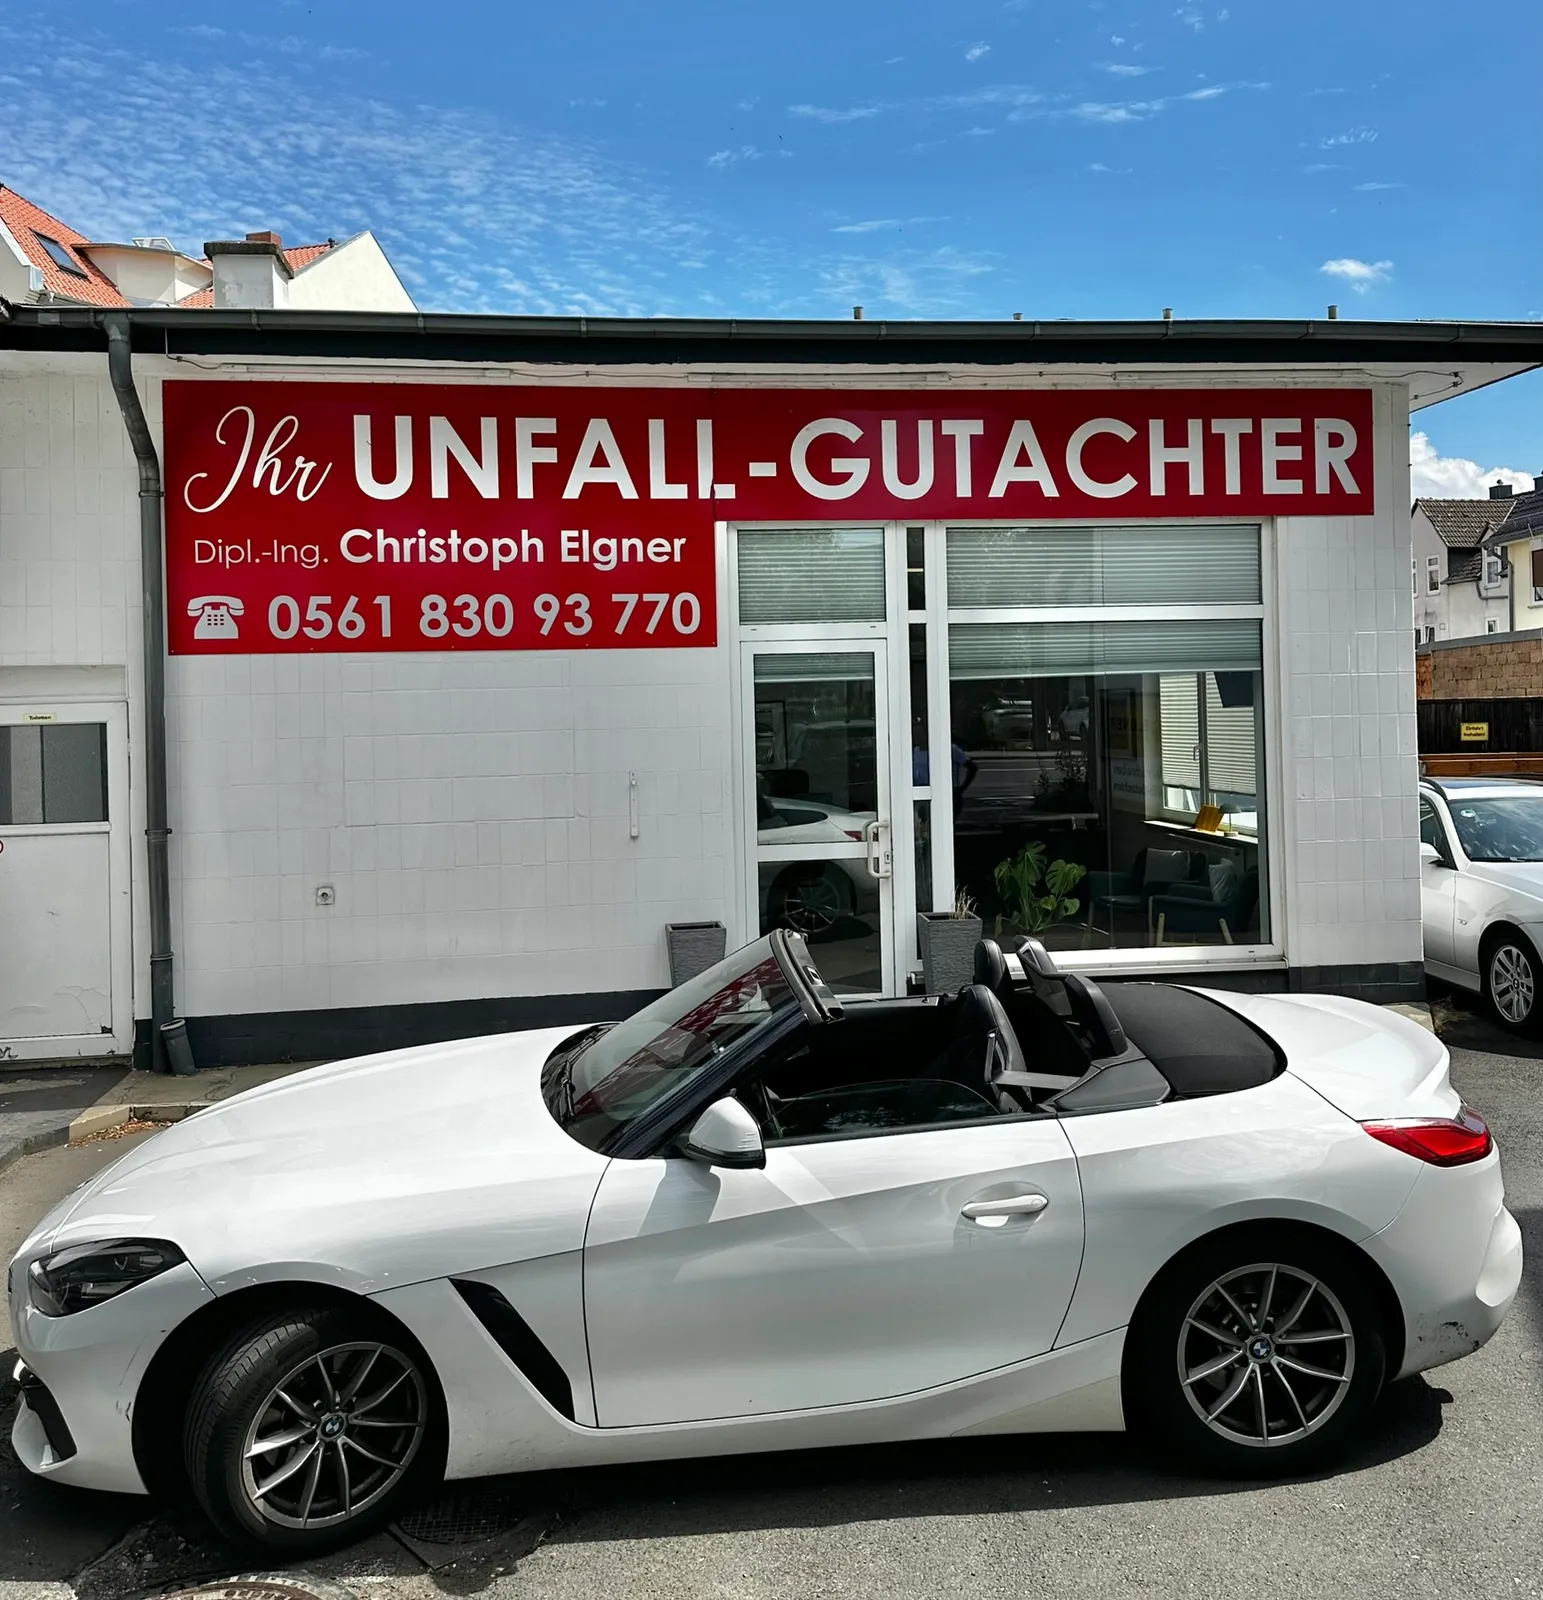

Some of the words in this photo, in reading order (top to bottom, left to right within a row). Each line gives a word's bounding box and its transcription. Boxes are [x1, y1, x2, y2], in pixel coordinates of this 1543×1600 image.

[183, 405, 333, 513] Ihr
[194, 538, 329, 570] Dipl.-Ing.
[339, 528, 544, 571] Christoph
[560, 529, 687, 572] Elgner
[268, 594, 392, 640] 0561
[419, 593, 514, 638] 830
[533, 592, 593, 636] 93
[611, 591, 701, 636] 770
